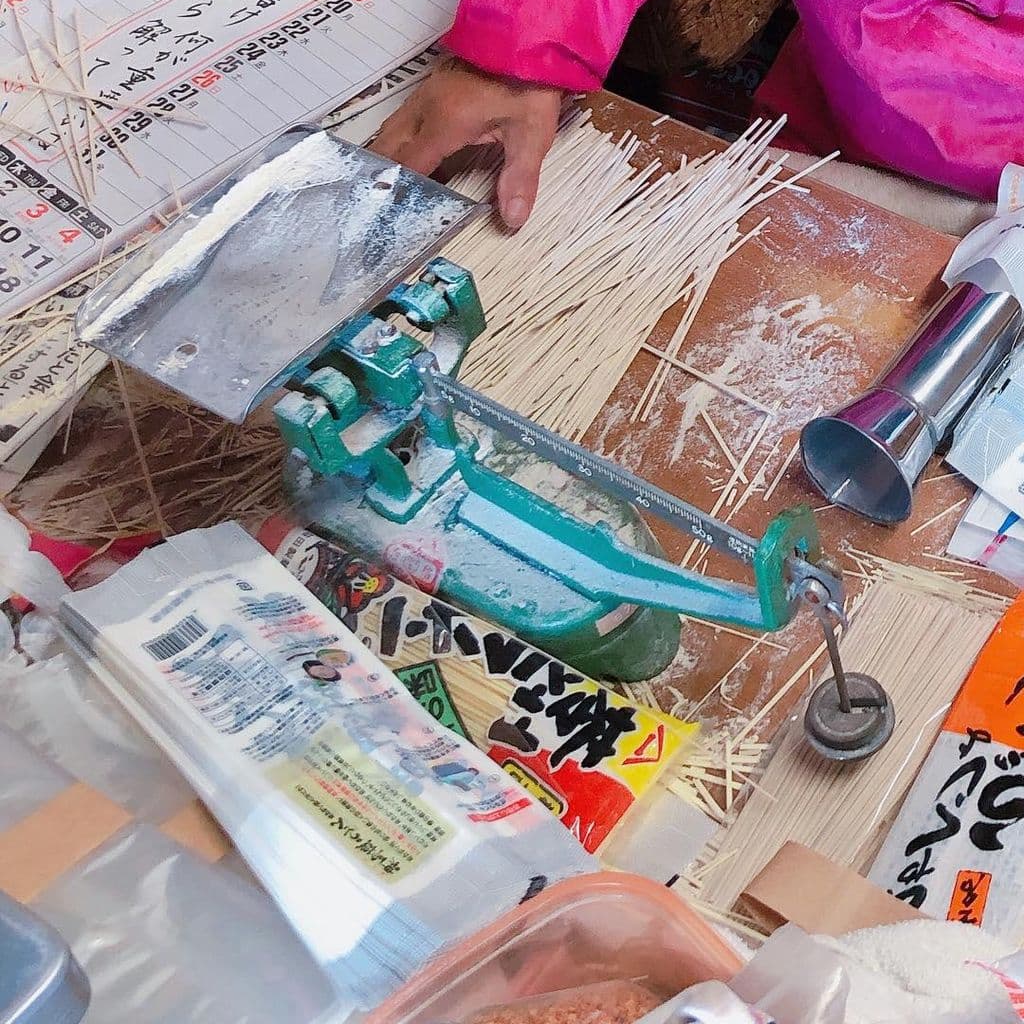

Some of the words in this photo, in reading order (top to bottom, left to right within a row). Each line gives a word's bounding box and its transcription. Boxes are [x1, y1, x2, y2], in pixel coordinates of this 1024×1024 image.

[302, 8, 332, 26] 21
[280, 20, 310, 40] 22
[258, 31, 288, 51] 23
[235, 42, 267, 62] 24
[213, 55, 244, 75] 25
[190, 69, 224, 90] 26
[168, 83, 199, 104] 27
[122, 111, 153, 134] 29
[8, 162, 27, 175] 木
[72, 210, 89, 223] 土
[26, 203, 49, 218] 3
[58, 229, 82, 244] 4
[22, 243, 54, 270] 11
[635, 495, 650, 507] 40
